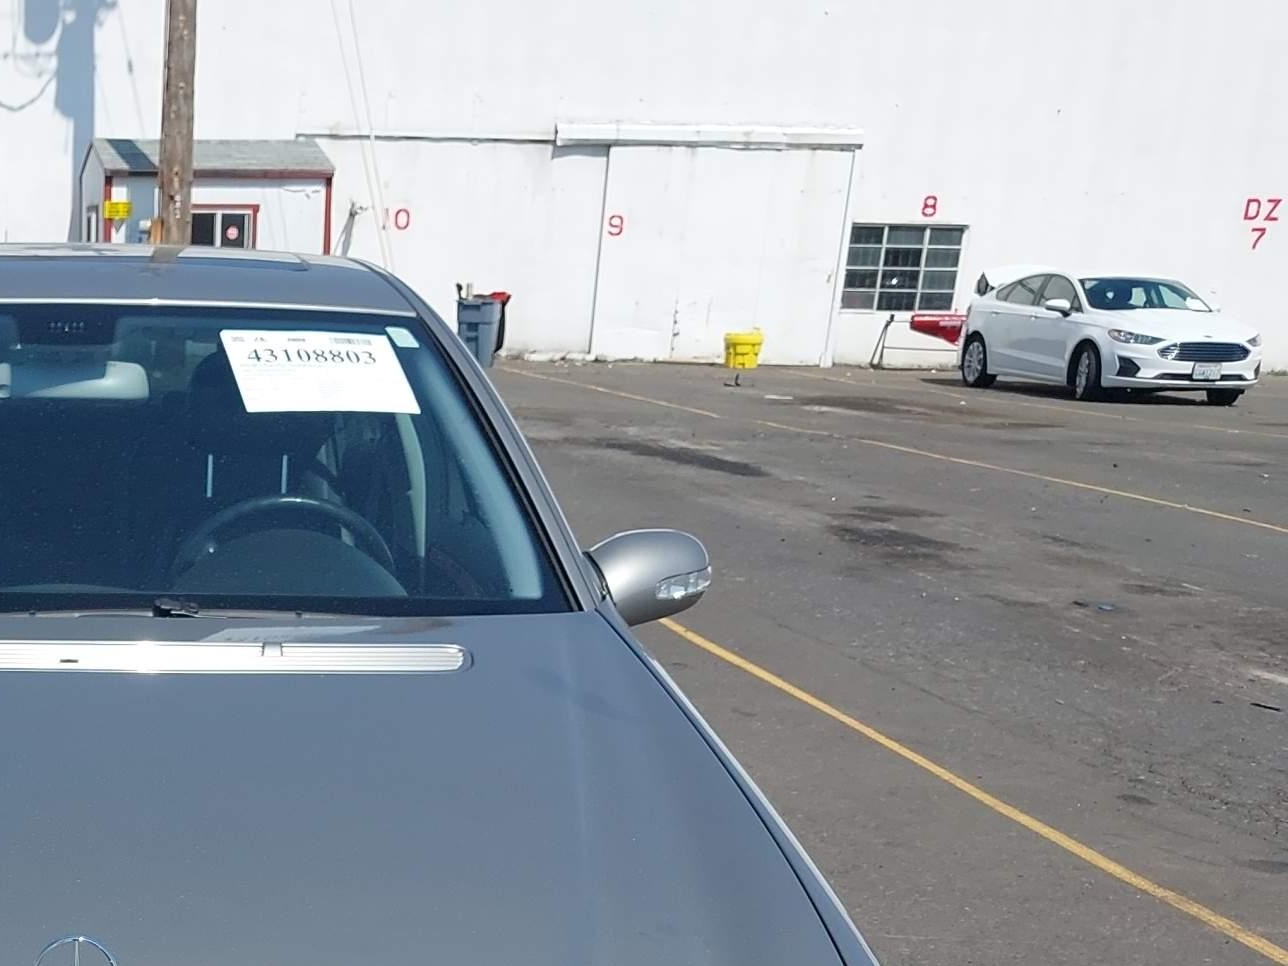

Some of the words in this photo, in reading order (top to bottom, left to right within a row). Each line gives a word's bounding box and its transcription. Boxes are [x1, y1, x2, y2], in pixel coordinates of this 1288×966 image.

[920, 195, 938, 218] 8
[608, 214, 624, 237] 9
[1250, 226, 1268, 250] 7
[247, 348, 377, 365] 43108803
